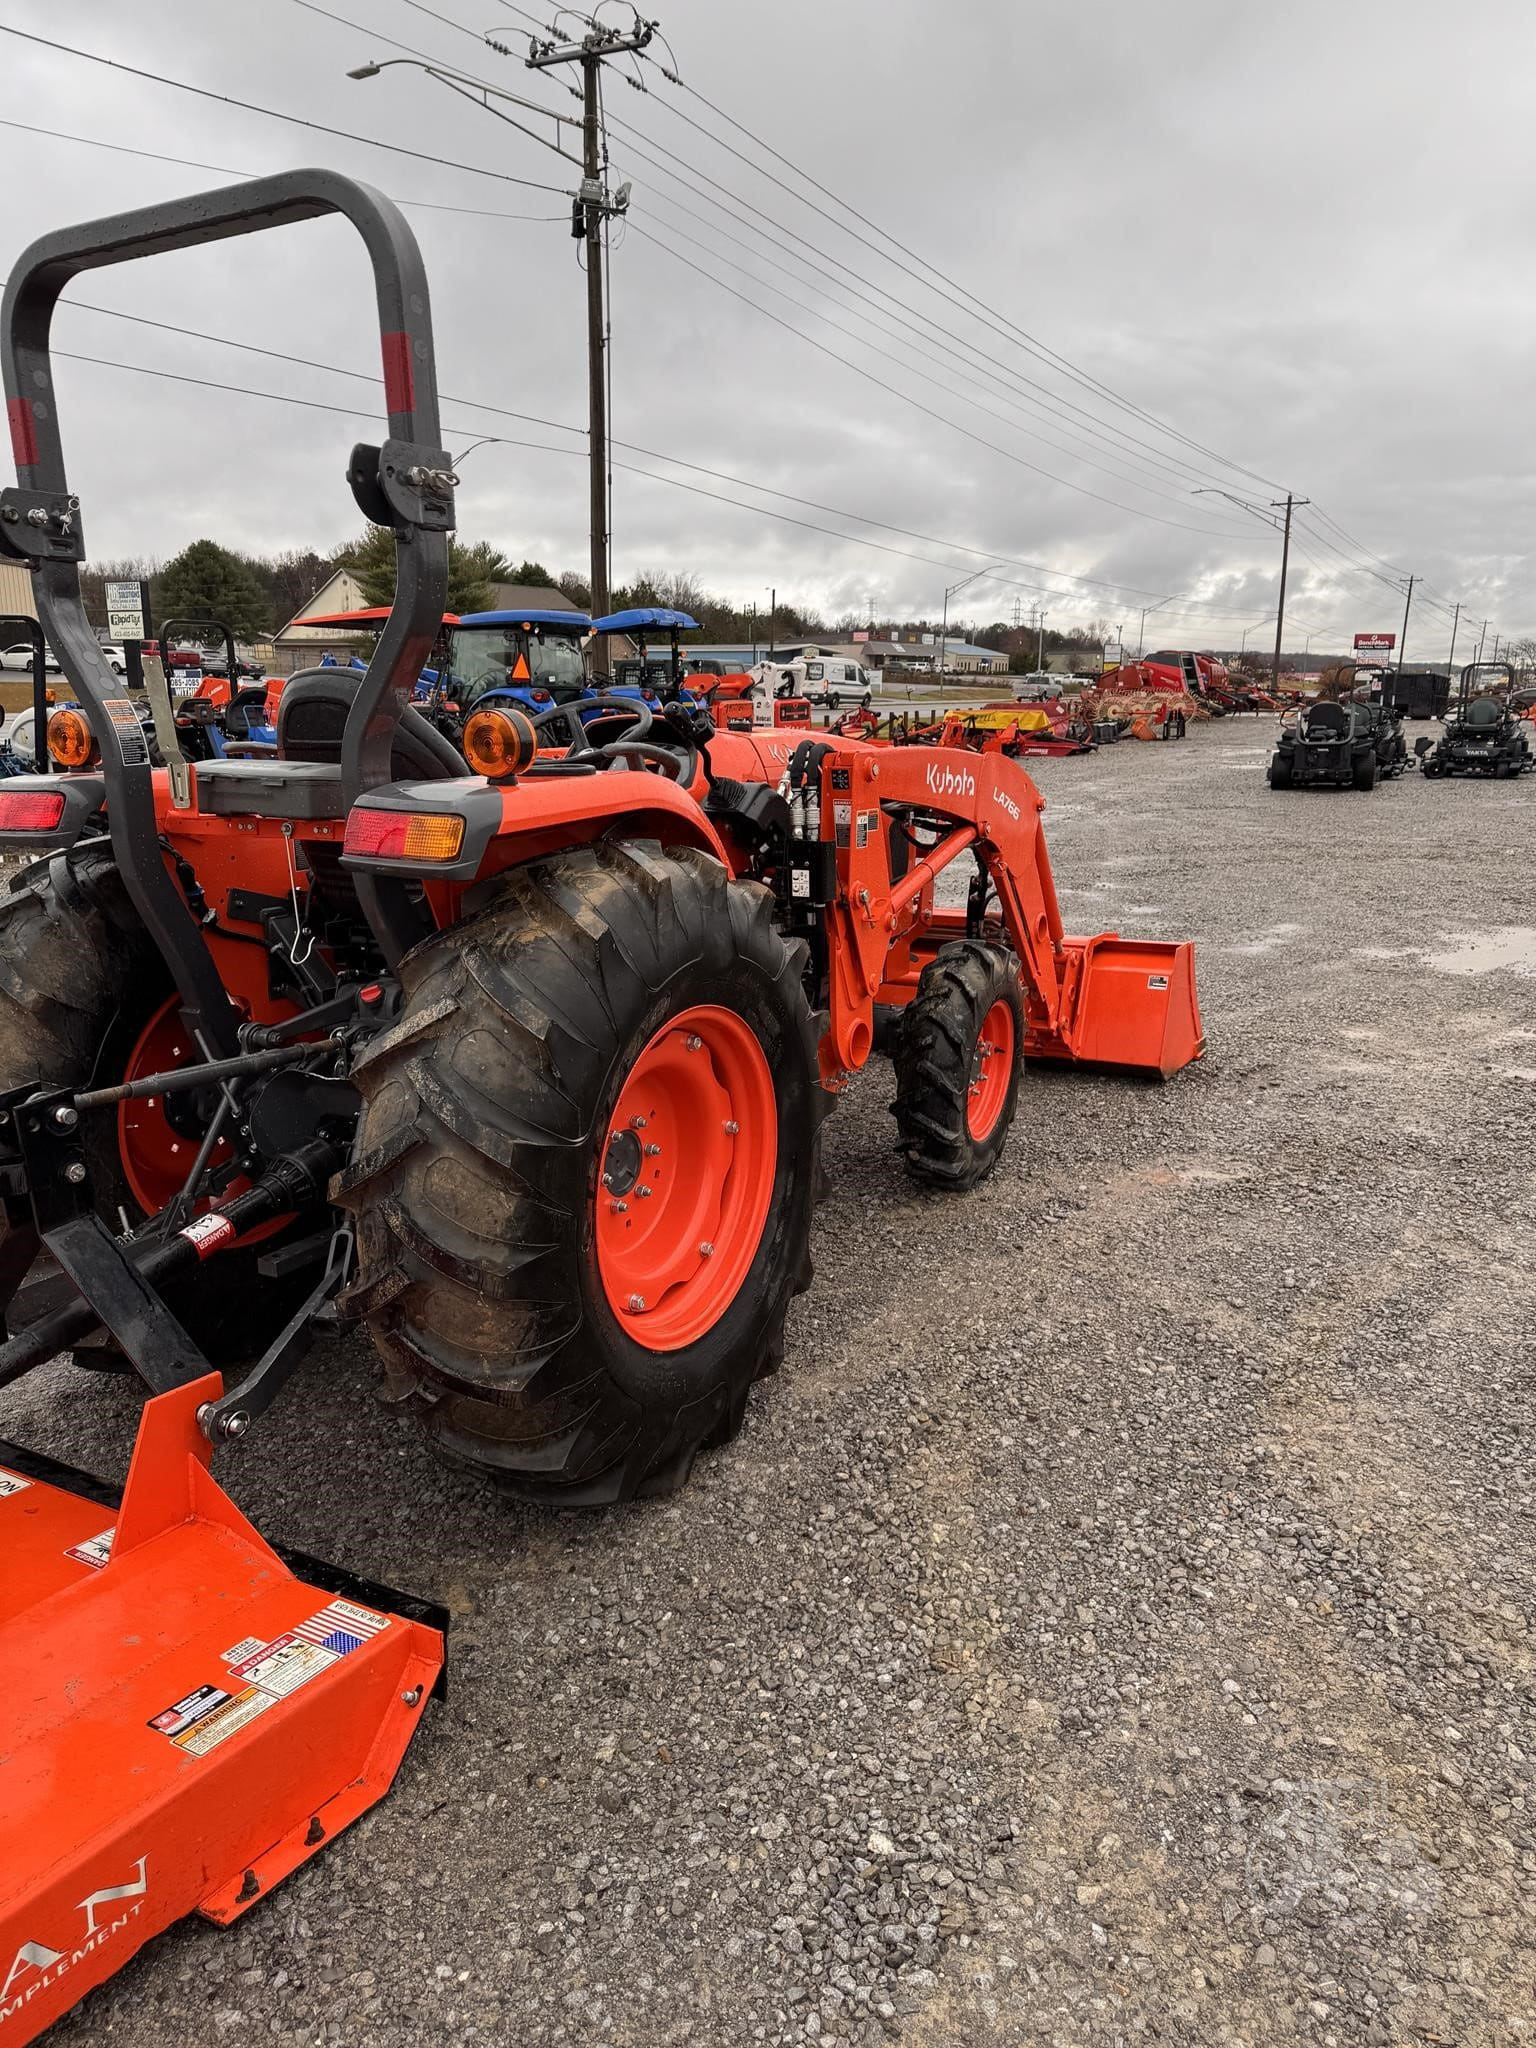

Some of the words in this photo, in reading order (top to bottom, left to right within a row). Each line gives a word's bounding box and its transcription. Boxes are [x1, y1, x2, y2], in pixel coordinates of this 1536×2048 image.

[926, 763, 975, 796] Kubota
[198, 1230, 225, 1250] DANGER
[248, 1639, 289, 1666] DANGER
[200, 1698, 244, 1728] WARNING
[0, 1899, 144, 2022] MPLEMENT
